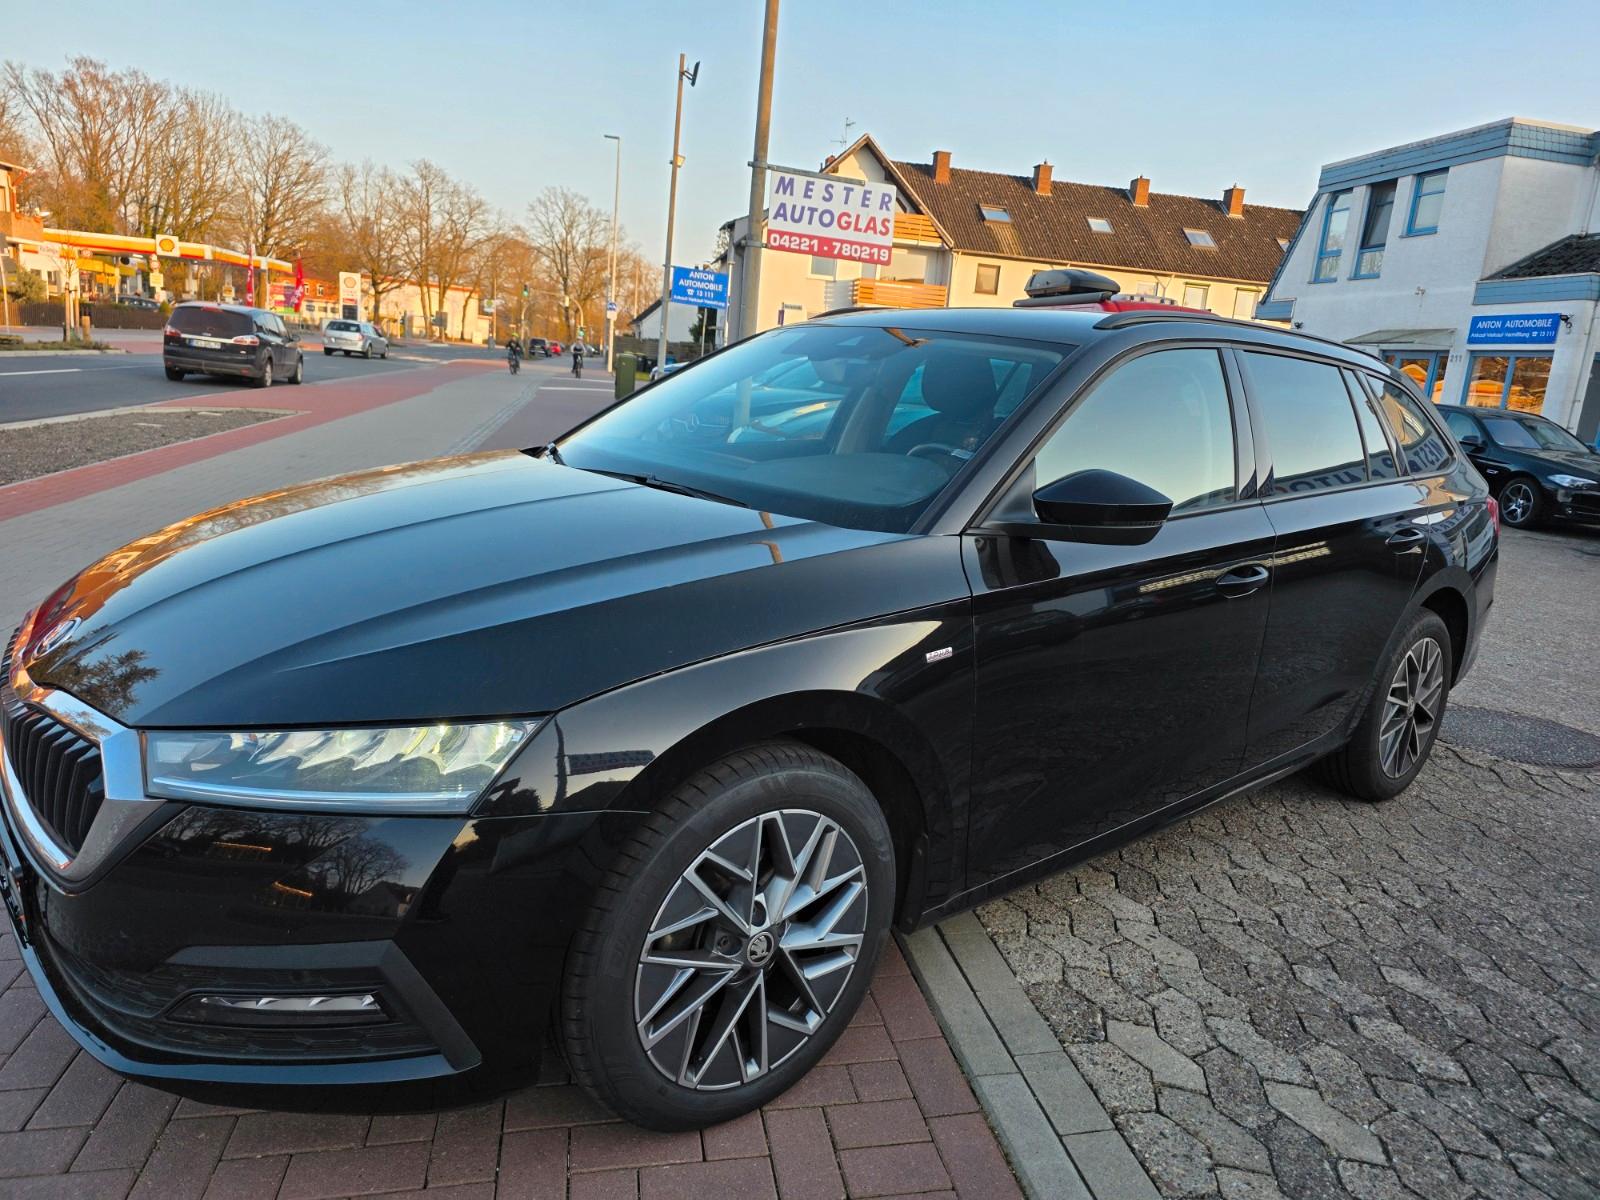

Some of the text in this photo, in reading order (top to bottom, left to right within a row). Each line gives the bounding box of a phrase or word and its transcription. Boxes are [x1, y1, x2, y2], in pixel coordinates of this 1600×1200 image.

[774, 176, 893, 212] MESTER
[772, 202, 891, 237] AUTOGLAS
[769, 233, 889, 262] 04221 780219
[678, 278, 723, 292] AUTOMOBILE
[688, 271, 715, 282] ANTON
[1477, 318, 1552, 329] ANTON AUTOMOBILE
